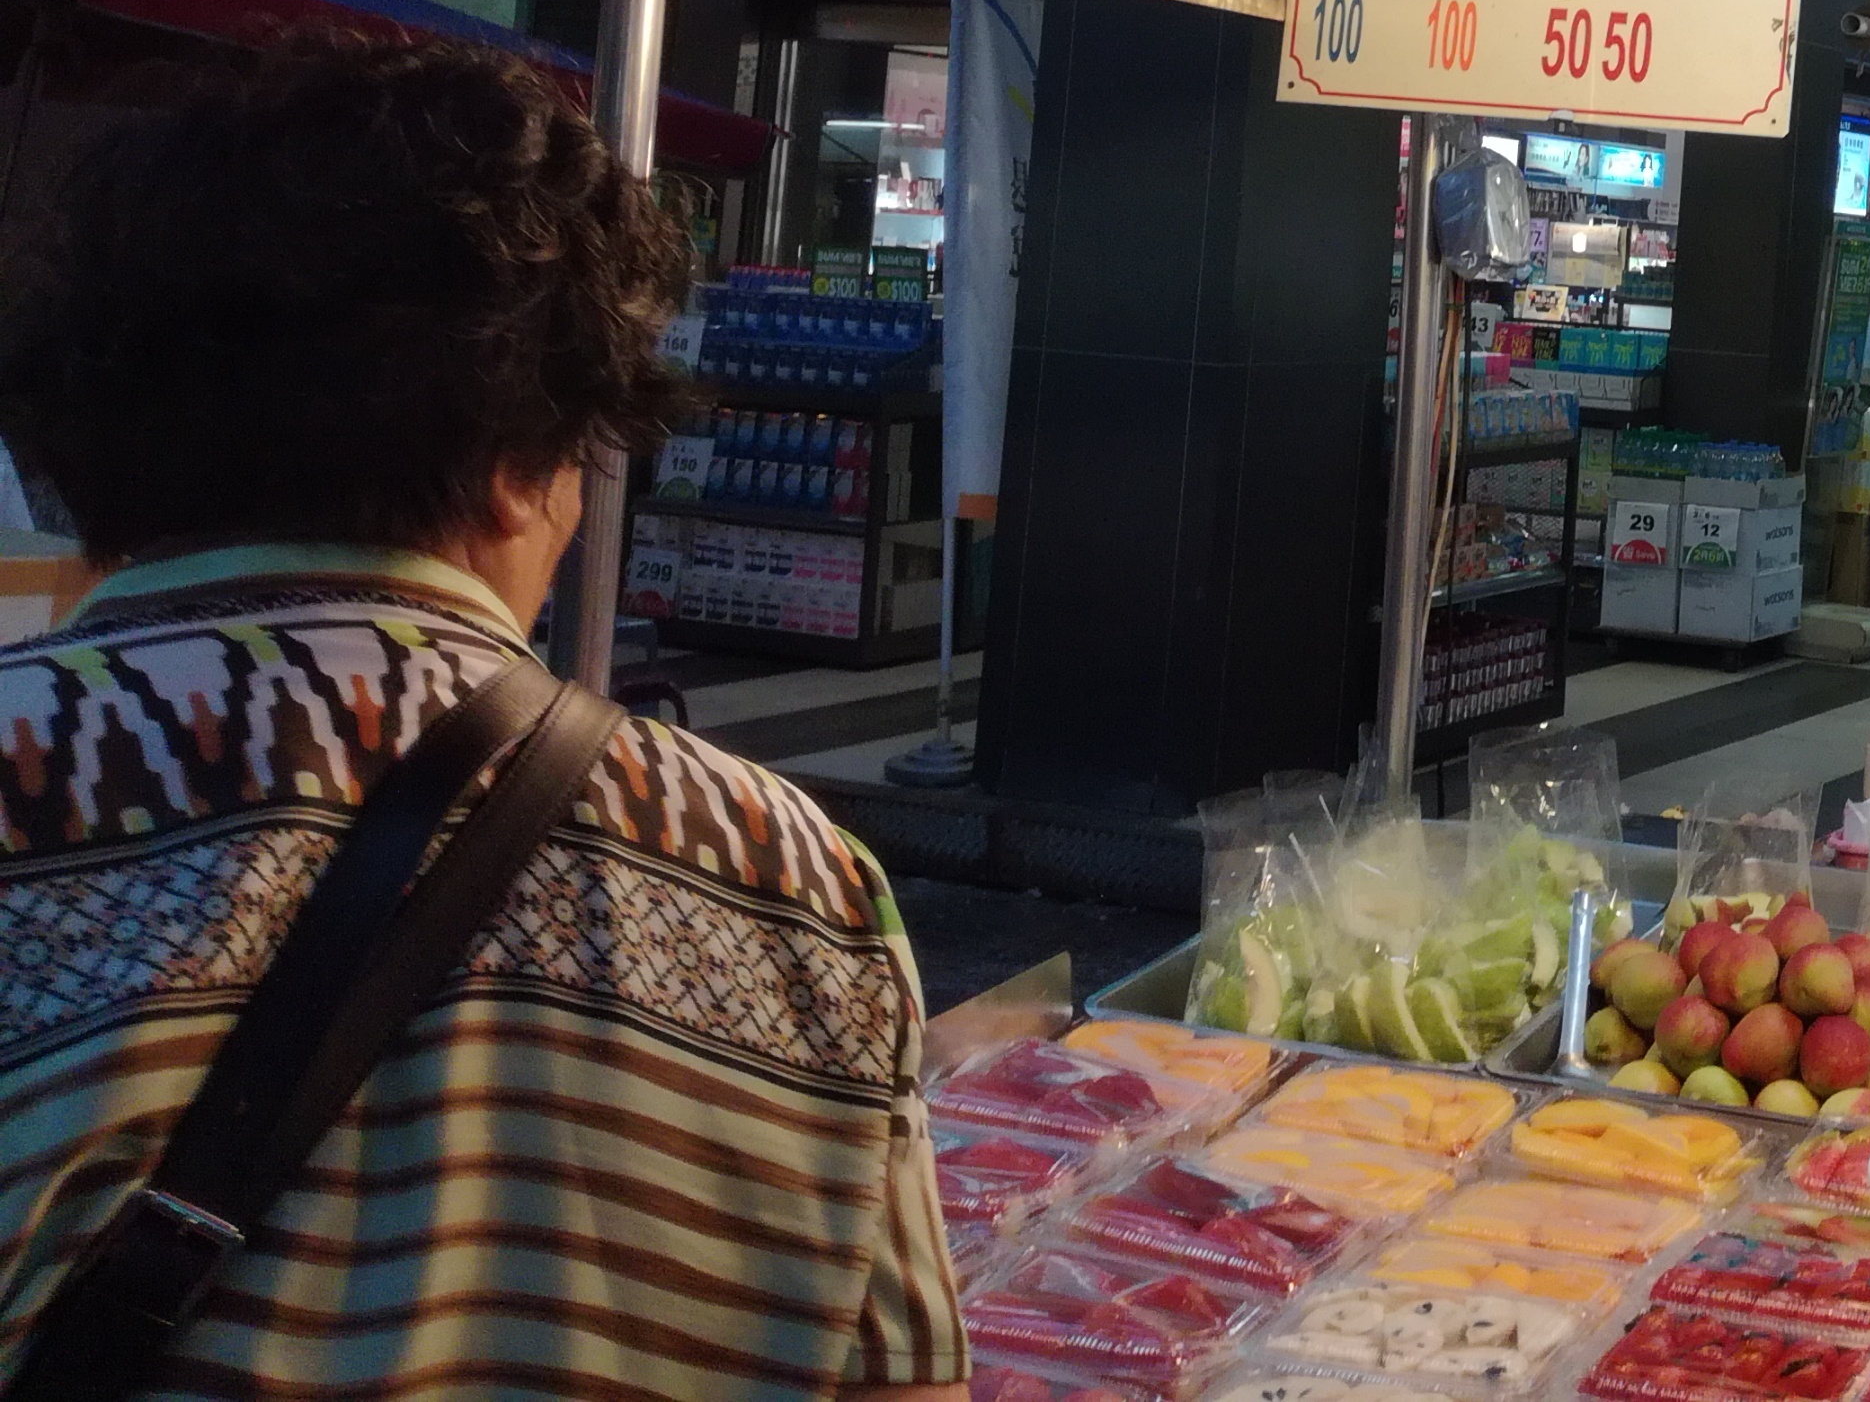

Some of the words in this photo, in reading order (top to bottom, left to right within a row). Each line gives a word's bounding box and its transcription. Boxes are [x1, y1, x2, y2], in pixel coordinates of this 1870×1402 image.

[1541, 8, 1593, 80] 50
[1602, 11, 1654, 84] 50
[1629, 514, 1655, 532] 29
[1700, 524, 1721, 538] 12
[636, 561, 673, 583] 299
